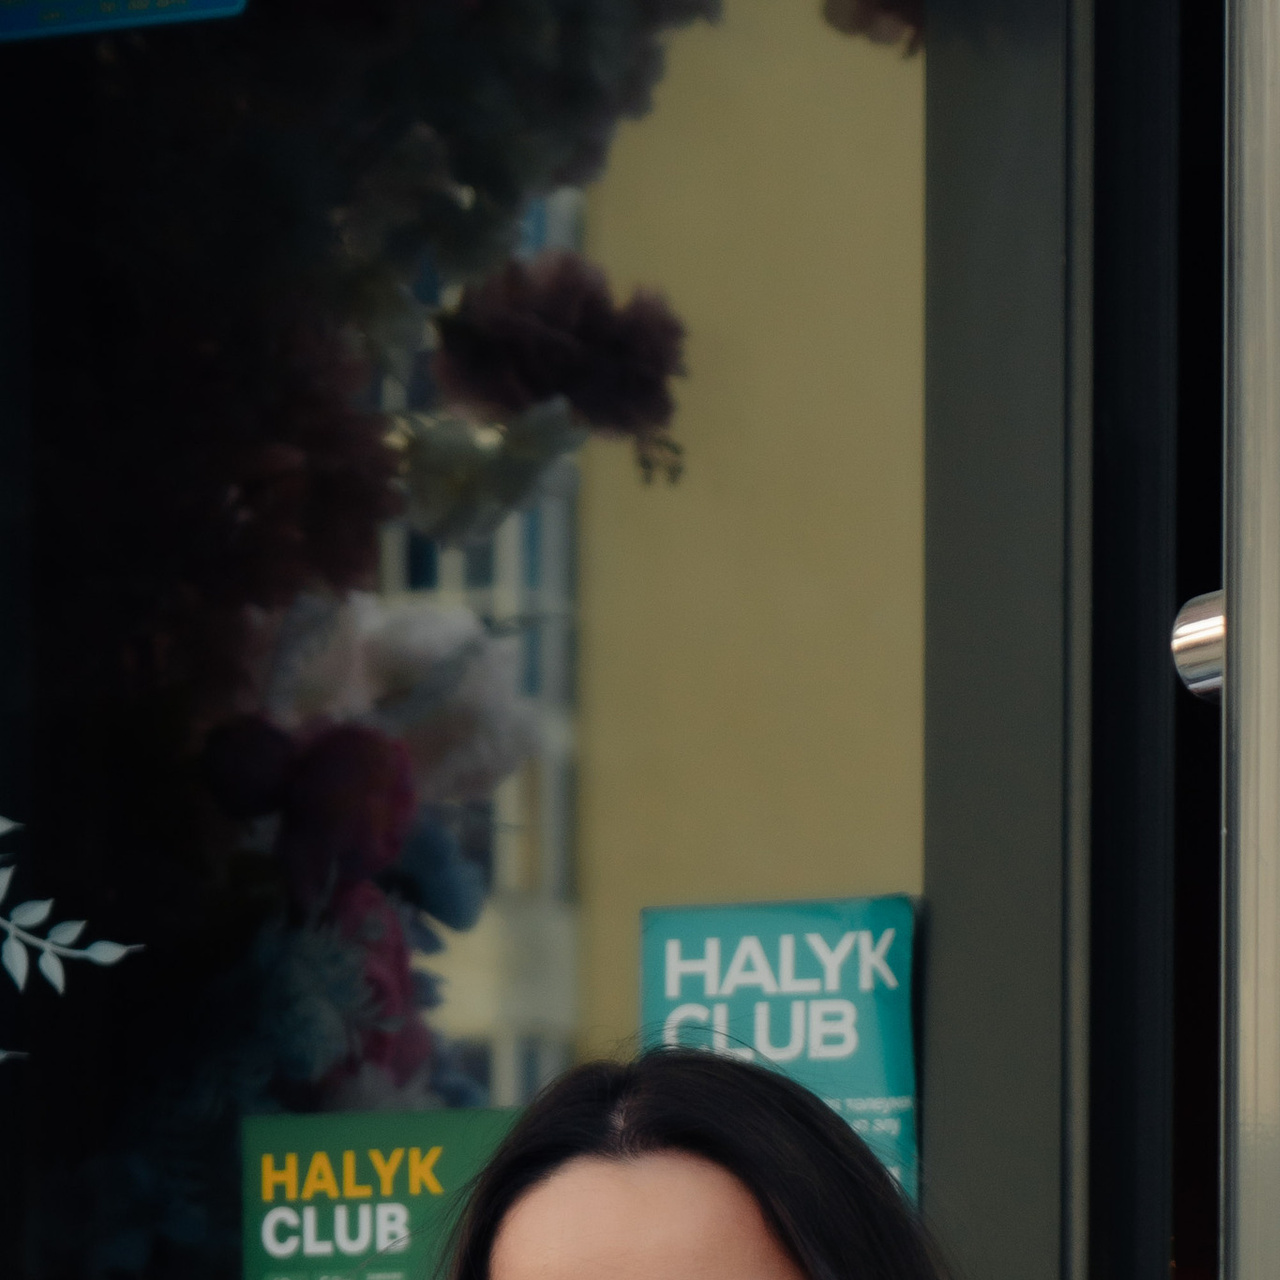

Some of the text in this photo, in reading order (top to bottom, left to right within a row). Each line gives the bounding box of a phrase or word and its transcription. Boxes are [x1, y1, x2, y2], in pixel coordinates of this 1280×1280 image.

[664, 927, 899, 999] HALYK
[663, 998, 859, 1062] CLUB
[261, 1146, 445, 1203] HALYK
[261, 1203, 411, 1259] CLUB
